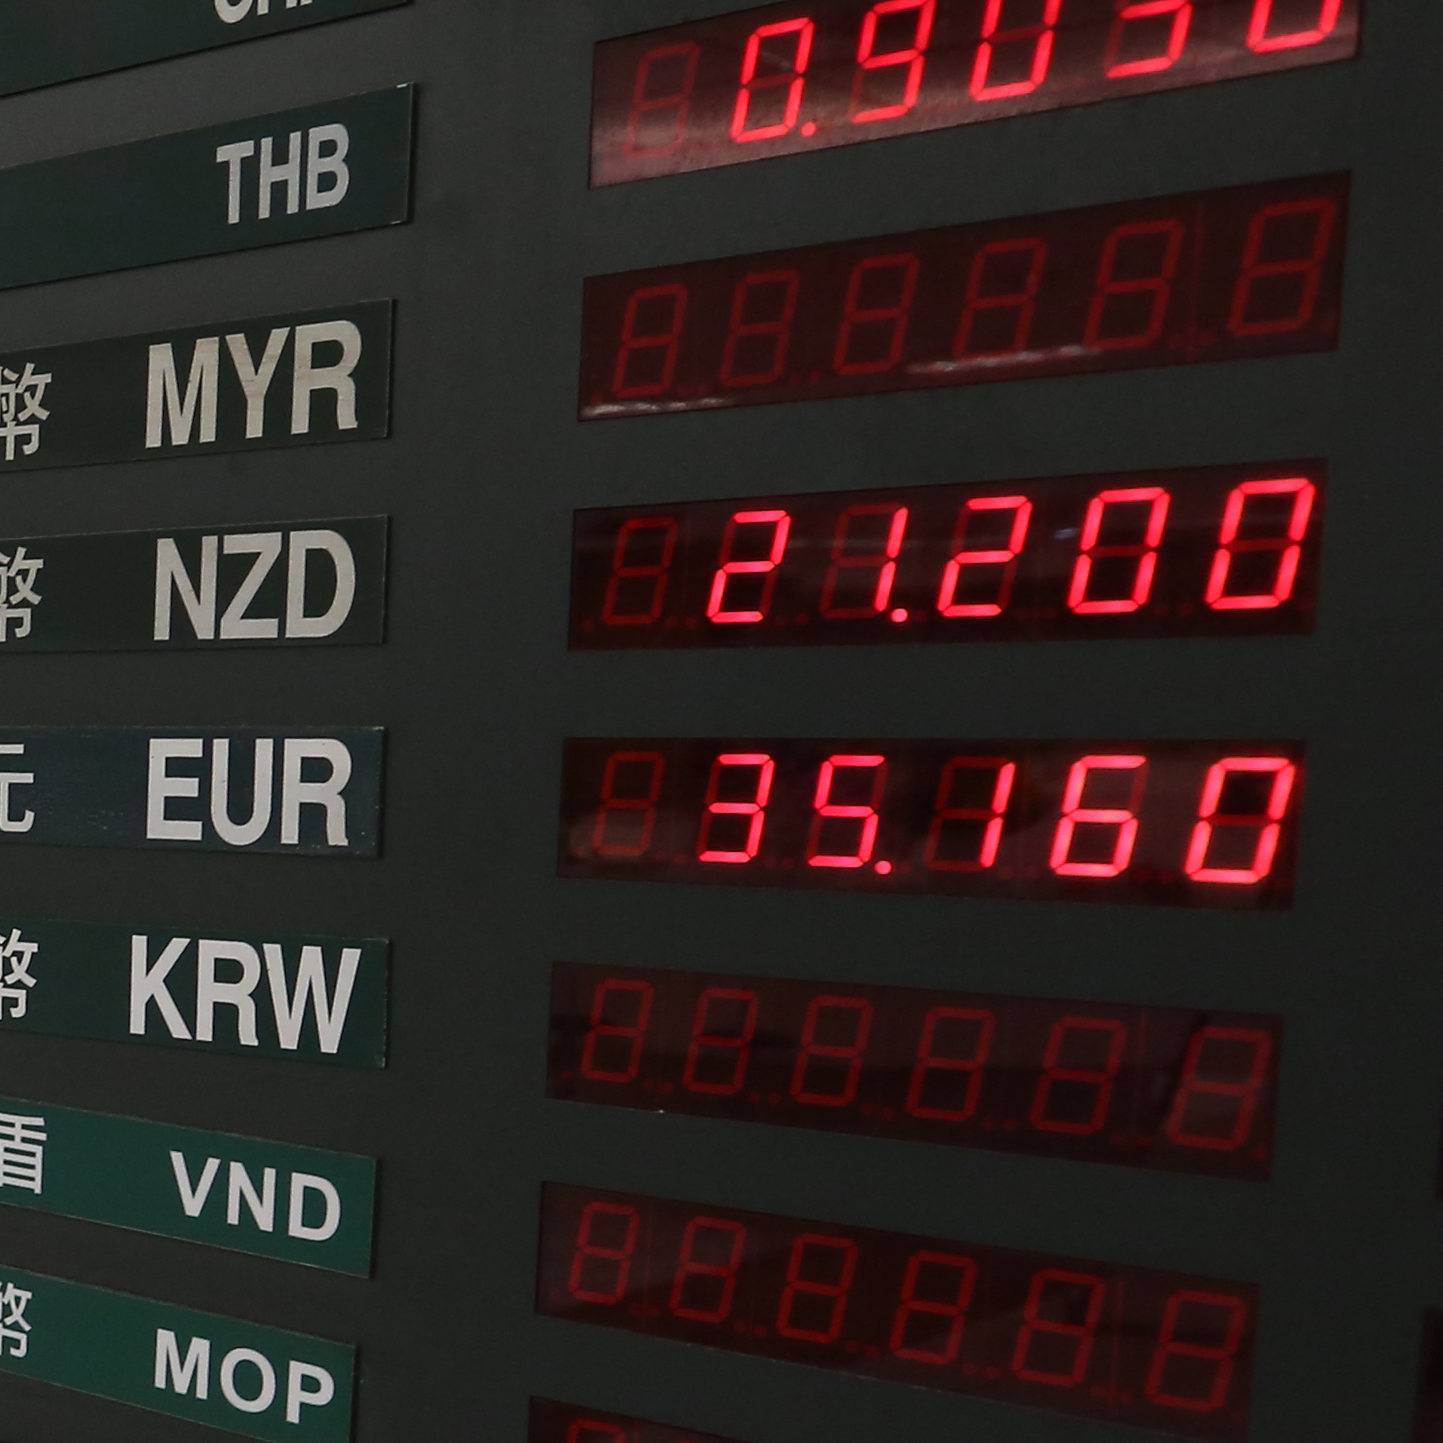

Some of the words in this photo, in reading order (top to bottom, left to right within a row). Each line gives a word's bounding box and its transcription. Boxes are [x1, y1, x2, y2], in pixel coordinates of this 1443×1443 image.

[217, 124, 349, 224] THB
[146, 320, 361, 448] MYR
[154, 530, 355, 640] NZD
[707, 479, 1315, 623] 21.200
[147, 739, 351, 846] EUR
[699, 754, 1295, 883] 35.160
[130, 935, 361, 1053] KRW
[170, 1151, 340, 1240] VND
[155, 1329, 334, 1423] MOP
